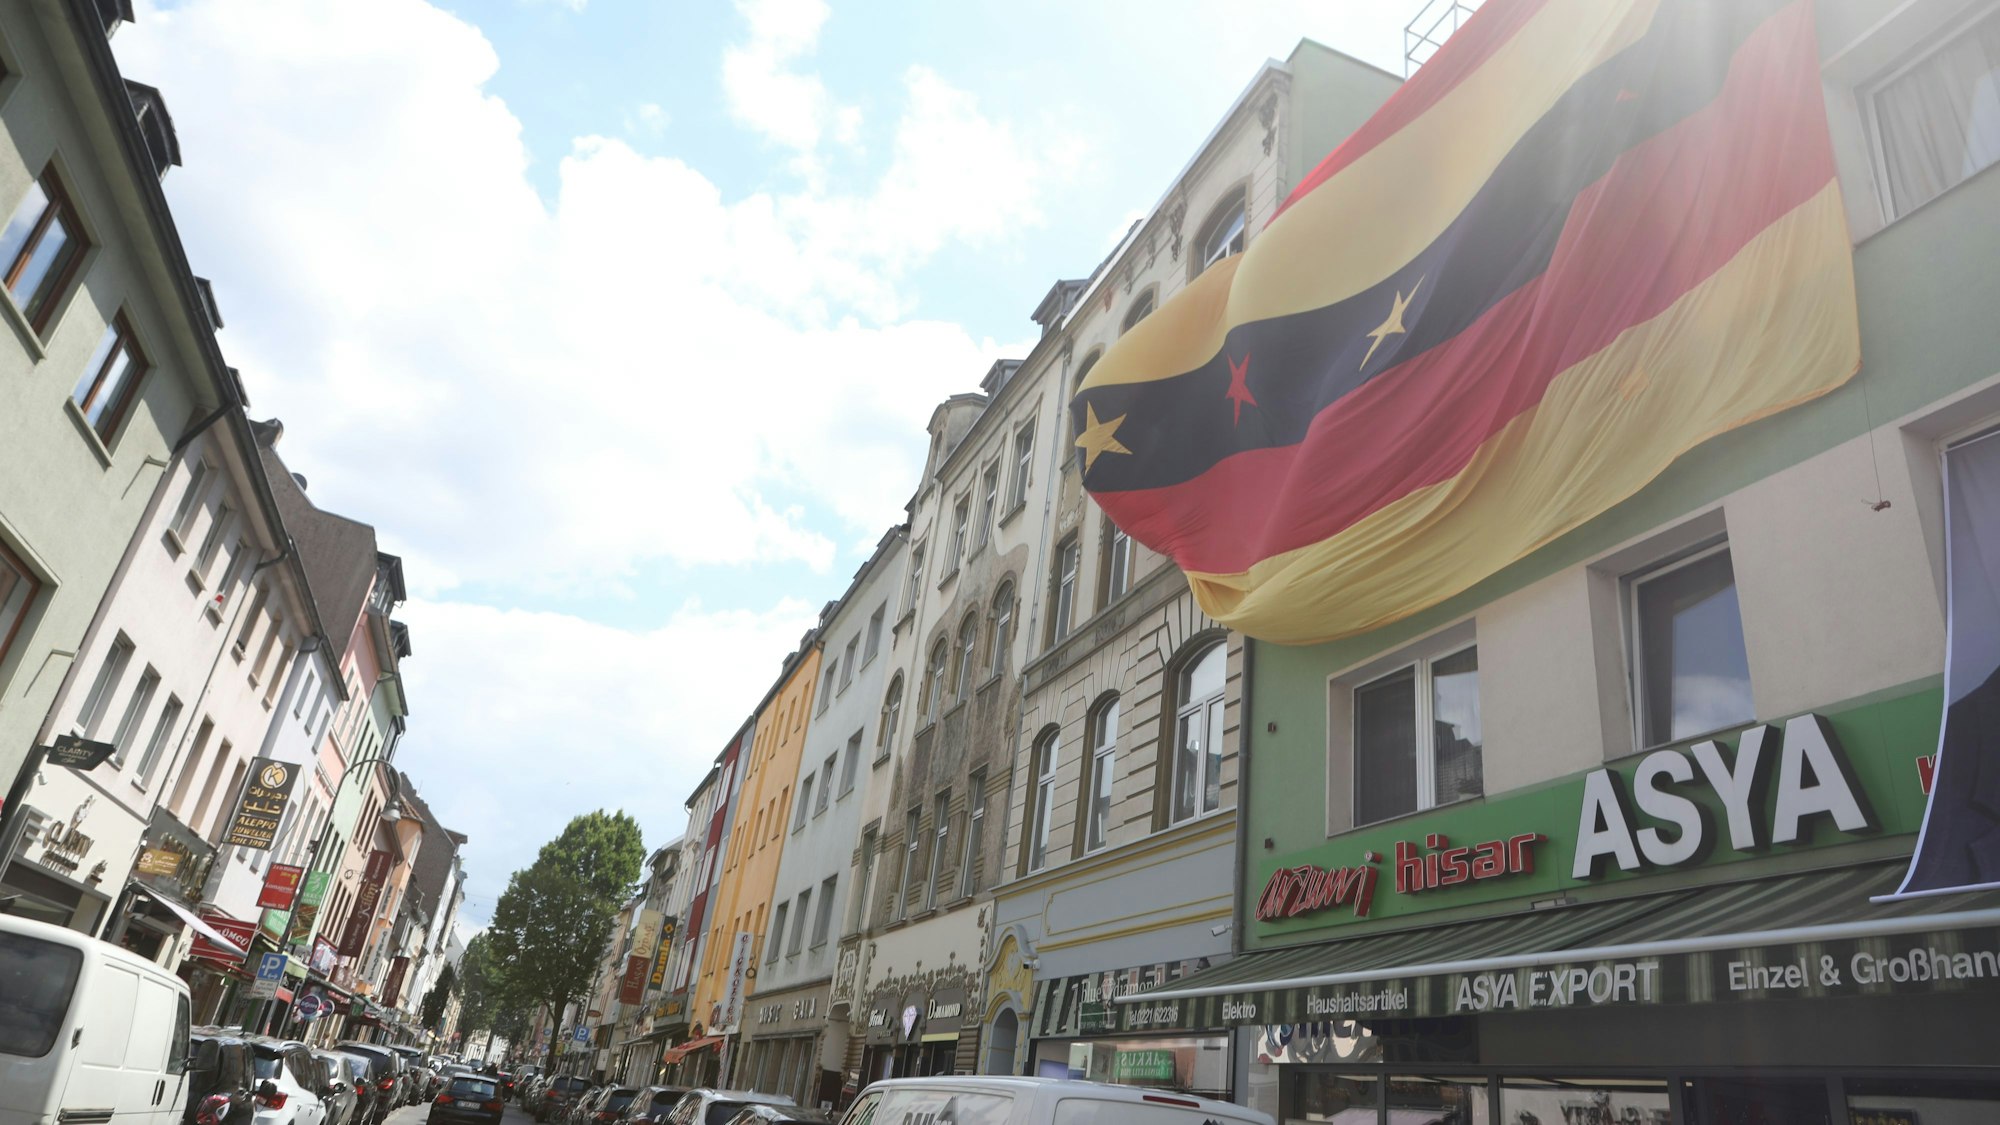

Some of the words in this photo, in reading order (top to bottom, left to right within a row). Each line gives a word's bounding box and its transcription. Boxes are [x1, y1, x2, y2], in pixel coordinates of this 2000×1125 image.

[56, 745, 94, 758] CLARITY
[1572, 712, 1870, 879] ASYA
[232, 826, 273, 839] JUWELIER
[237, 816, 277, 830] ALEPPO
[1395, 833, 1542, 894] hisar
[263, 957, 280, 976] P
[652, 939, 672, 984] Damla
[1728, 957, 1810, 991] Einzel
[1819, 954, 1842, 987] &
[1850, 947, 2000, 985] Großhan
[1455, 974, 1519, 1011] ASYA
[1528, 961, 1659, 1006] EXPORT
[1221, 1002, 1257, 1021] Elektro
[1306, 988, 1408, 1015] Haushaltsartikel
[578, 1027, 588, 1040] P
